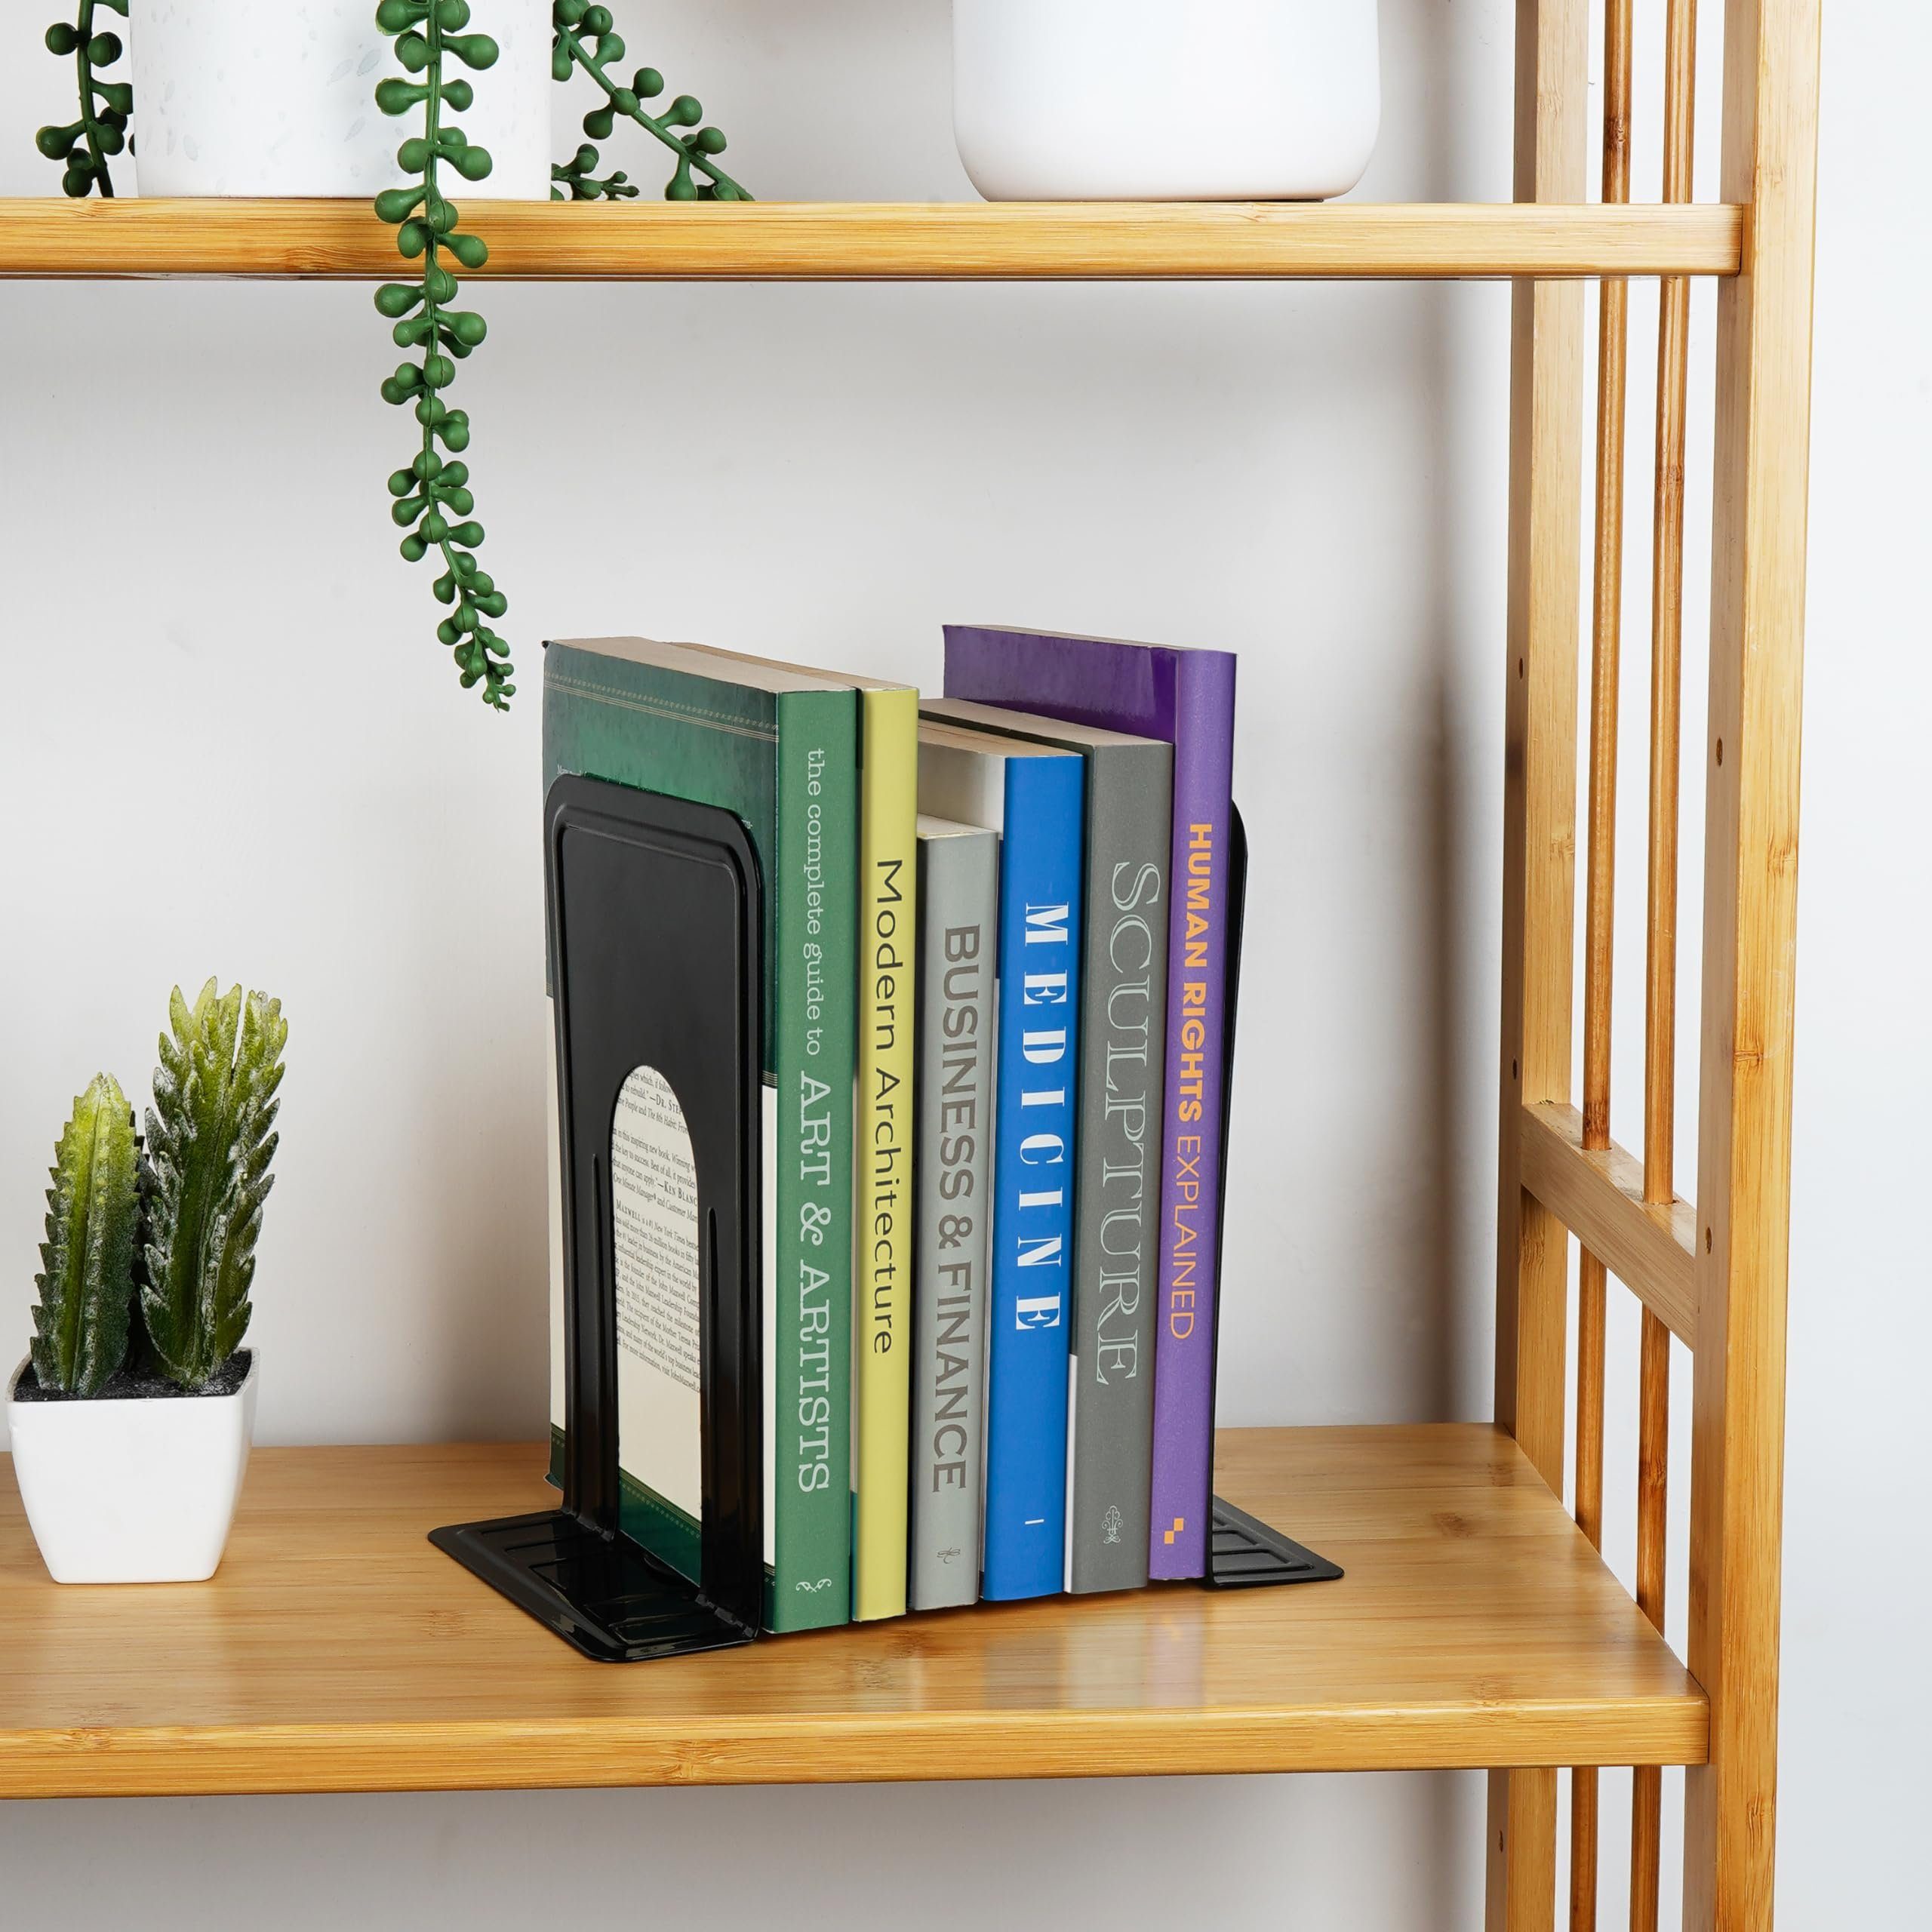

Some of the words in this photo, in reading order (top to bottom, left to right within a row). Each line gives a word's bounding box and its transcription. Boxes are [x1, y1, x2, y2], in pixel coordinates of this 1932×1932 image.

[808, 748, 826, 796] the
[803, 804, 825, 935] complete
[1184, 823, 1213, 968] HUMAN
[803, 943, 824, 1020] guide
[875, 859, 904, 1051] Modern
[806, 1026, 823, 1056] to
[939, 923, 980, 1200] BUSINESS
[1177, 981, 1208, 1123] RIGHTS
[800, 1070, 832, 1186] ART
[1015, 902, 1069, 1331] MEDICINE
[1096, 861, 1161, 1386] SCULPTURE
[678, 1187, 697, 1207] BLANC
[800, 1201, 832, 1246] &
[873, 1067, 902, 1354] Architecture
[938, 1214, 974, 1250] &
[1170, 1135, 1201, 1340] EXPLAINED
[798, 1259, 830, 1493] ARTISTS
[932, 1260, 973, 1493] FINANCE
